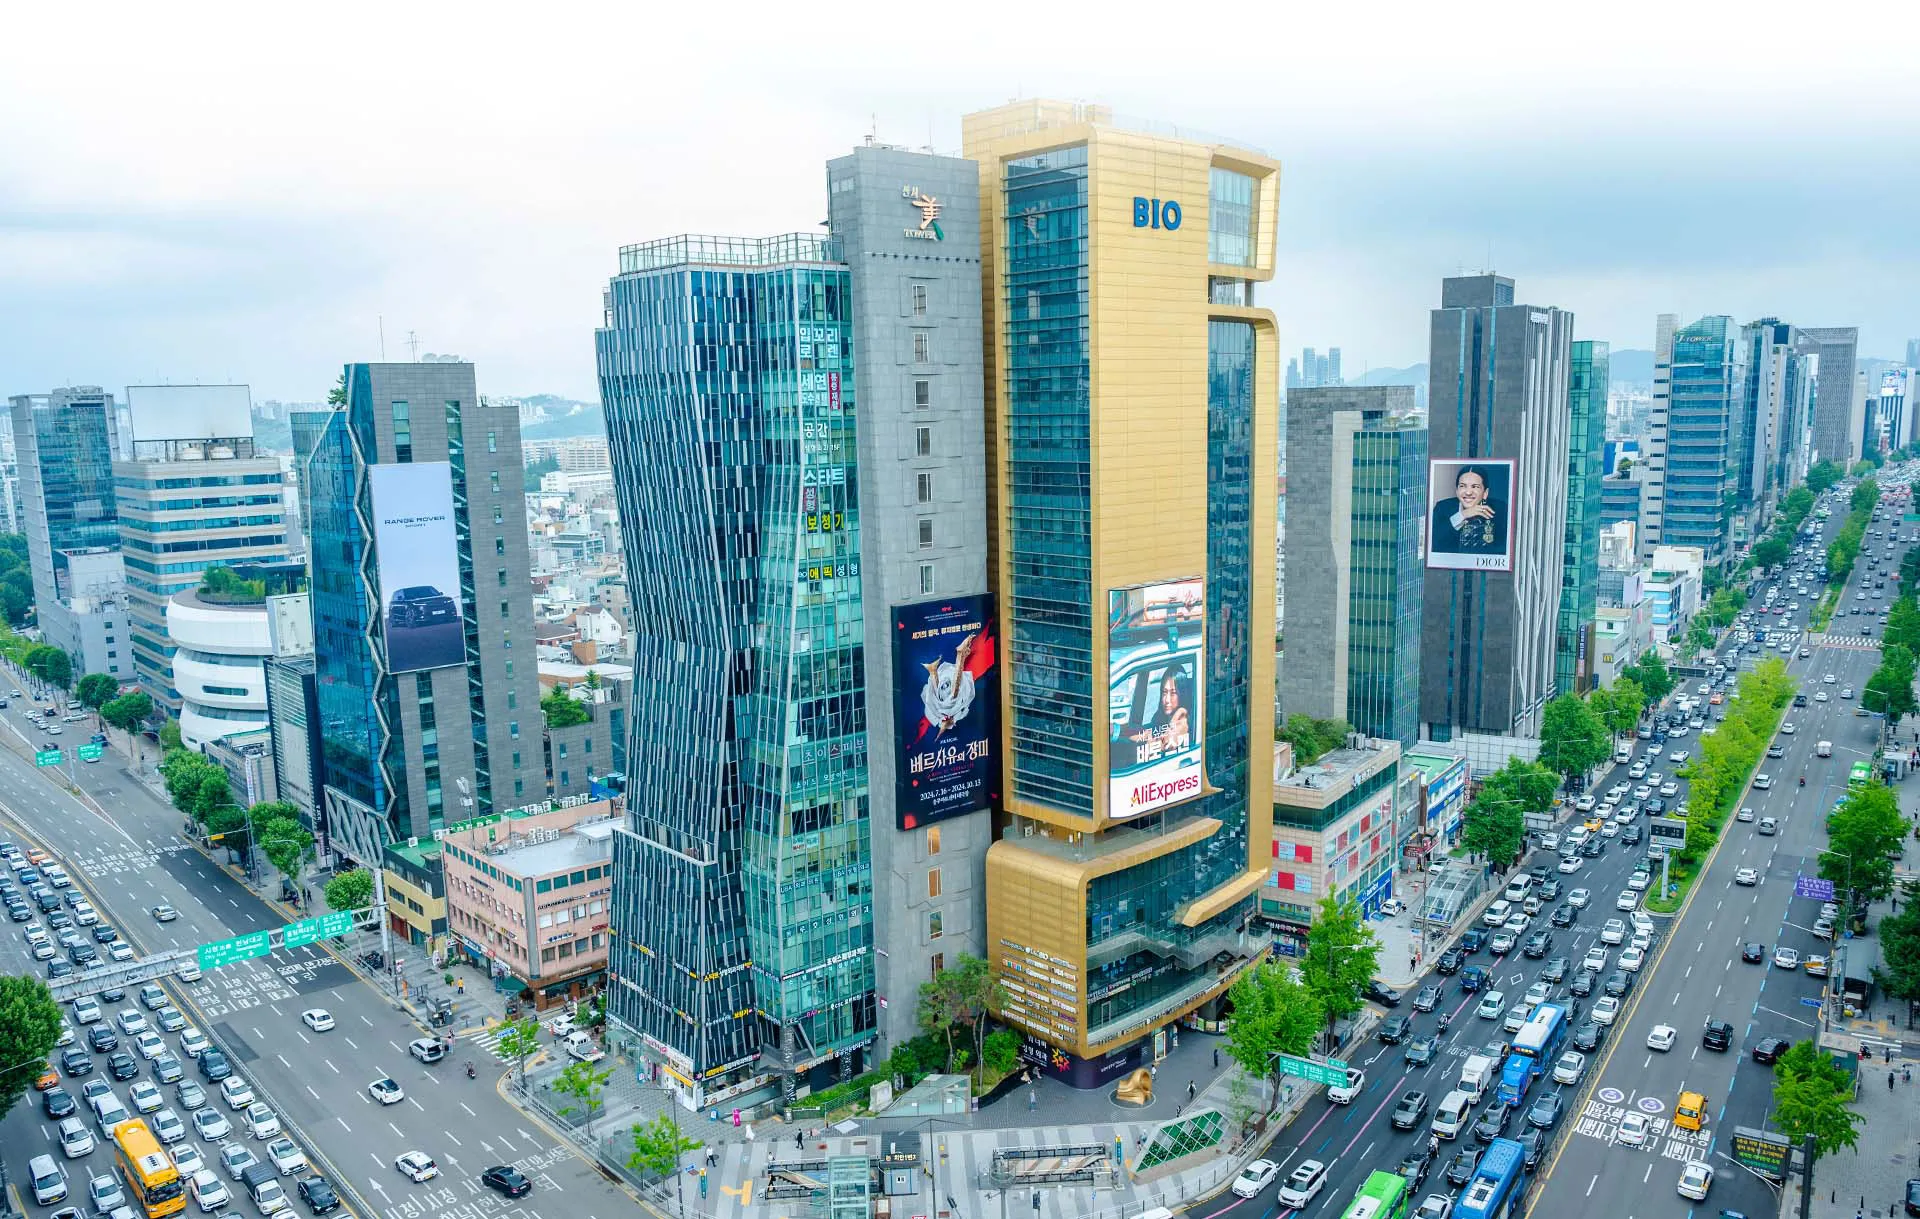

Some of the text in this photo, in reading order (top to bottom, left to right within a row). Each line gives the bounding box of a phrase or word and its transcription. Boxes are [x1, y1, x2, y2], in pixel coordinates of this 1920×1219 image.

[1133, 197, 1182, 230] BIO
[800, 327, 837, 342] 입꼬리
[802, 373, 826, 390] 세연
[804, 422, 828, 438] 공간
[804, 468, 845, 486] 스타트
[808, 513, 844, 531] 보청기
[1476, 558, 1505, 567] DIOR
[910, 746, 965, 774] 베르사유의
[966, 738, 989, 760] 장미
[1136, 741, 1162, 764] 바로
[1131, 775, 1198, 805] AliExpress
[1581, 1099, 1625, 1123] 자율주행
[421, 1187, 460, 1210] 시청
